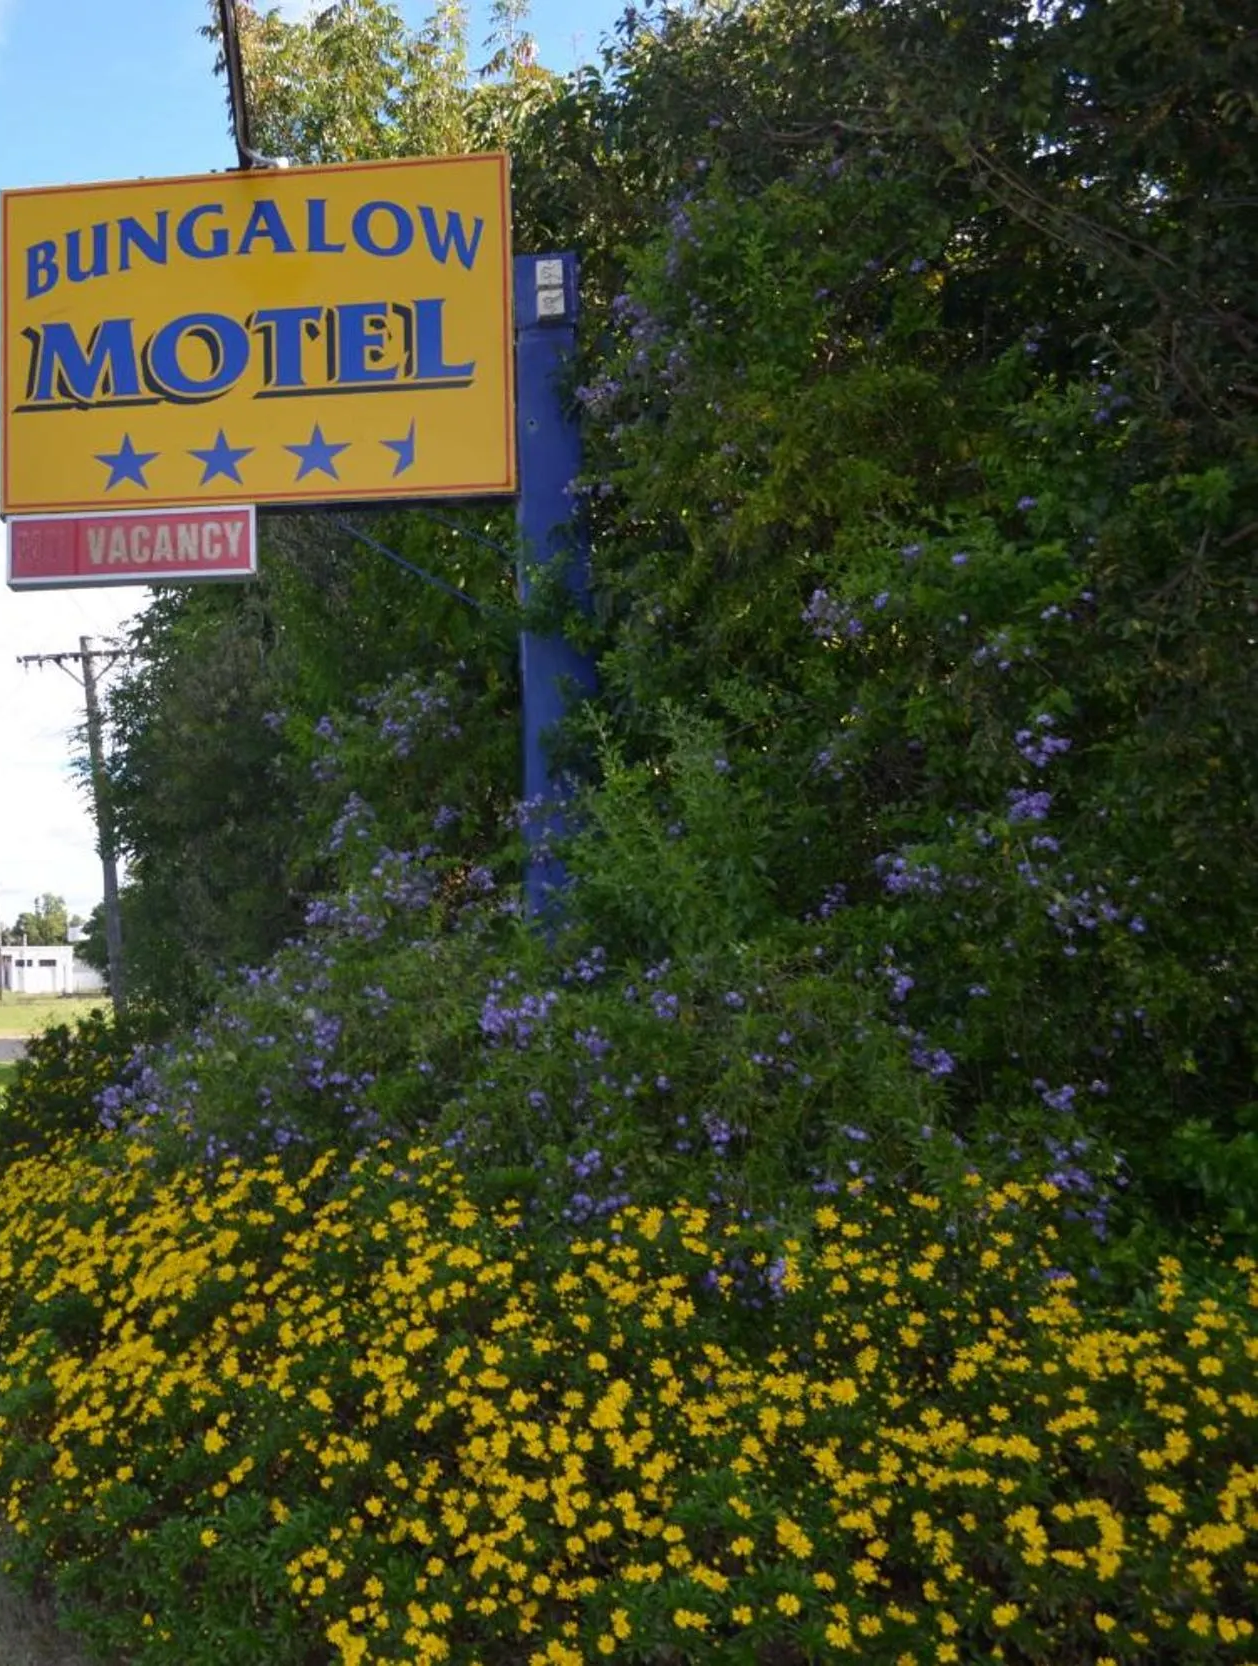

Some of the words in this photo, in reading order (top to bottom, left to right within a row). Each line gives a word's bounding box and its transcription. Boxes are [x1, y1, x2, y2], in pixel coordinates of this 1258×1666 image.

[25, 198, 483, 299] BUNGALOW
[17, 299, 476, 408] MOTEL
[87, 521, 243, 565] VACANCY
